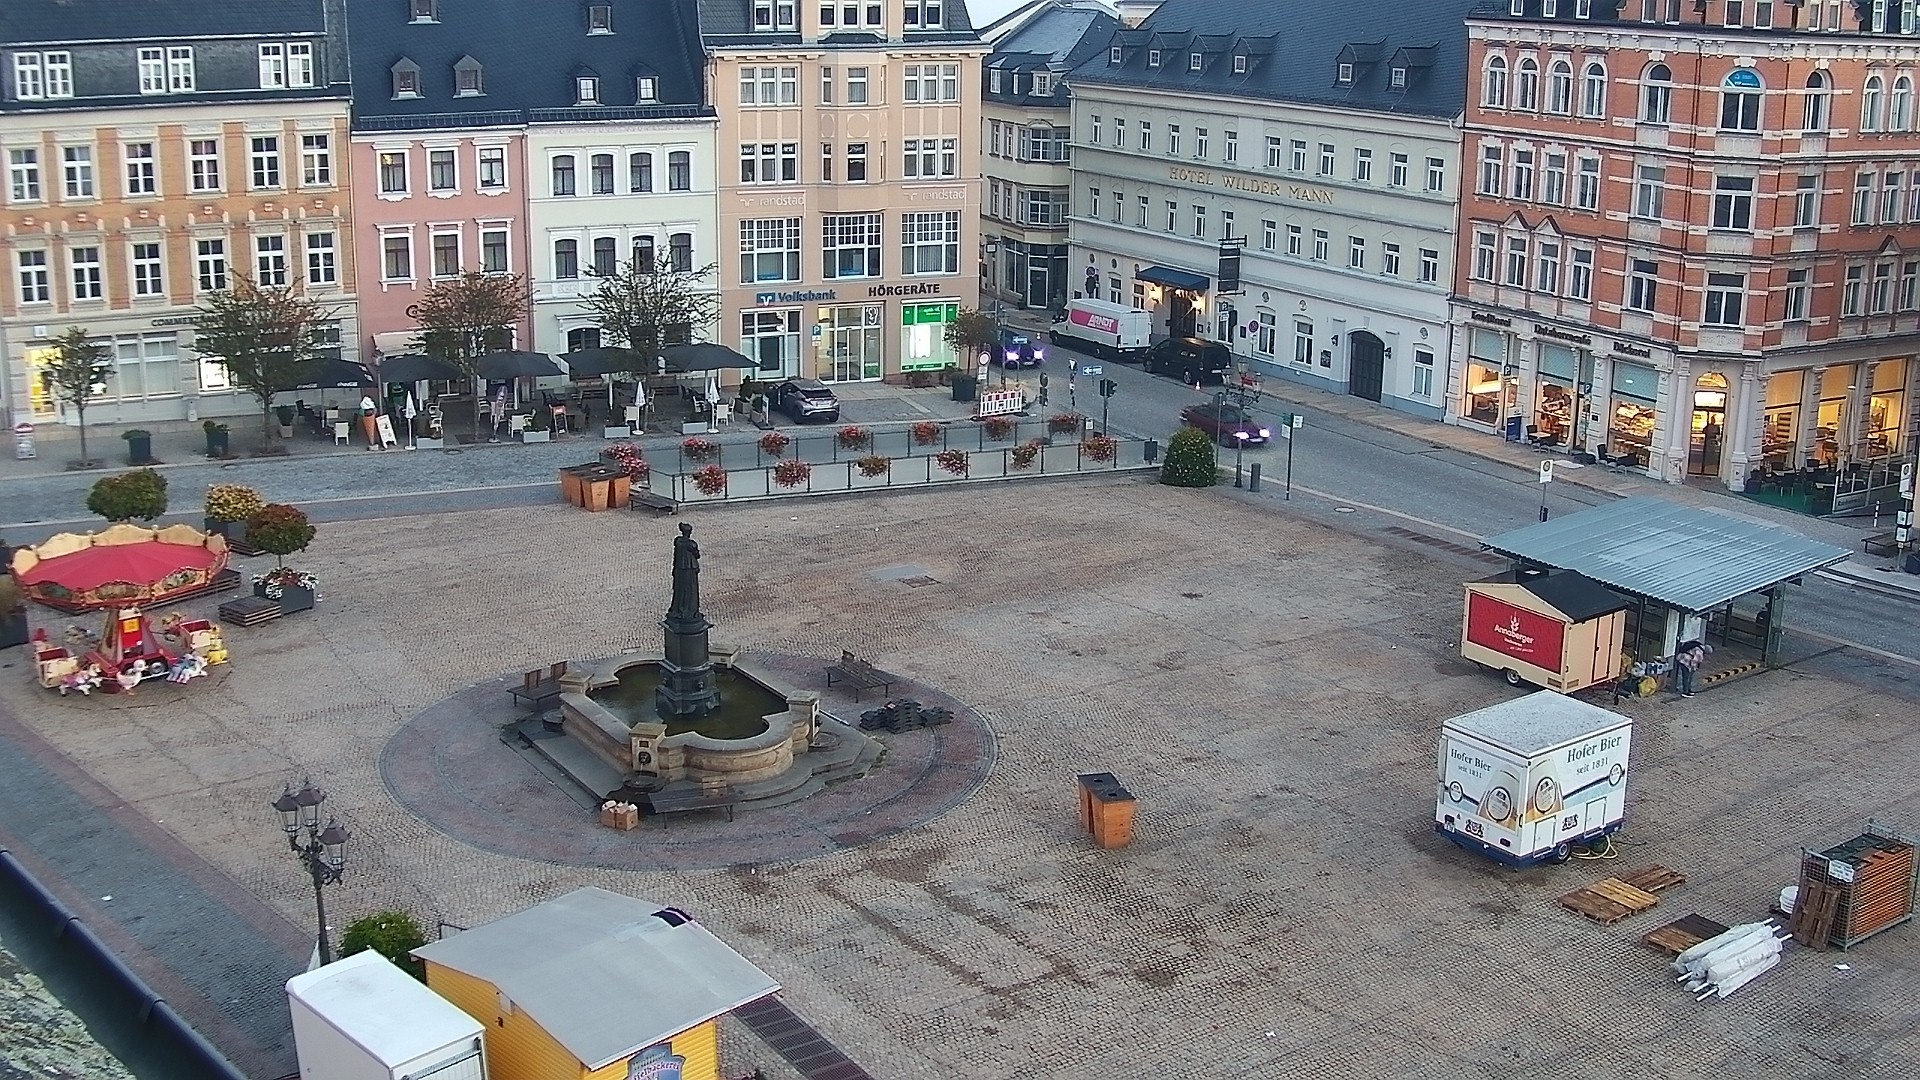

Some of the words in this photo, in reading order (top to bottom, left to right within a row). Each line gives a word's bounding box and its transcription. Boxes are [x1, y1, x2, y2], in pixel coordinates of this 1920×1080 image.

[1168, 166, 1214, 186] HOTEL
[1221, 174, 1280, 197] WILDER
[1288, 185, 1334, 205] MANN
[759, 194, 805, 206] randstad
[922, 188, 965, 200] randstad
[777, 289, 837, 302] Volksbank
[868, 283, 941, 297] HÖRGERÄTE
[1087, 314, 1114, 328] ARNDT
[1493, 623, 1535, 644] Annaberger
[1567, 743, 1598, 763] Hofer
[1600, 735, 1622, 753] Bier
[1450, 748, 1473, 765] Hofer
[1474, 757, 1492, 772] Bier
[1576, 763, 1590, 775] seit
[1591, 757, 1608, 771] 1831
[1458, 764, 1468, 773] seit
